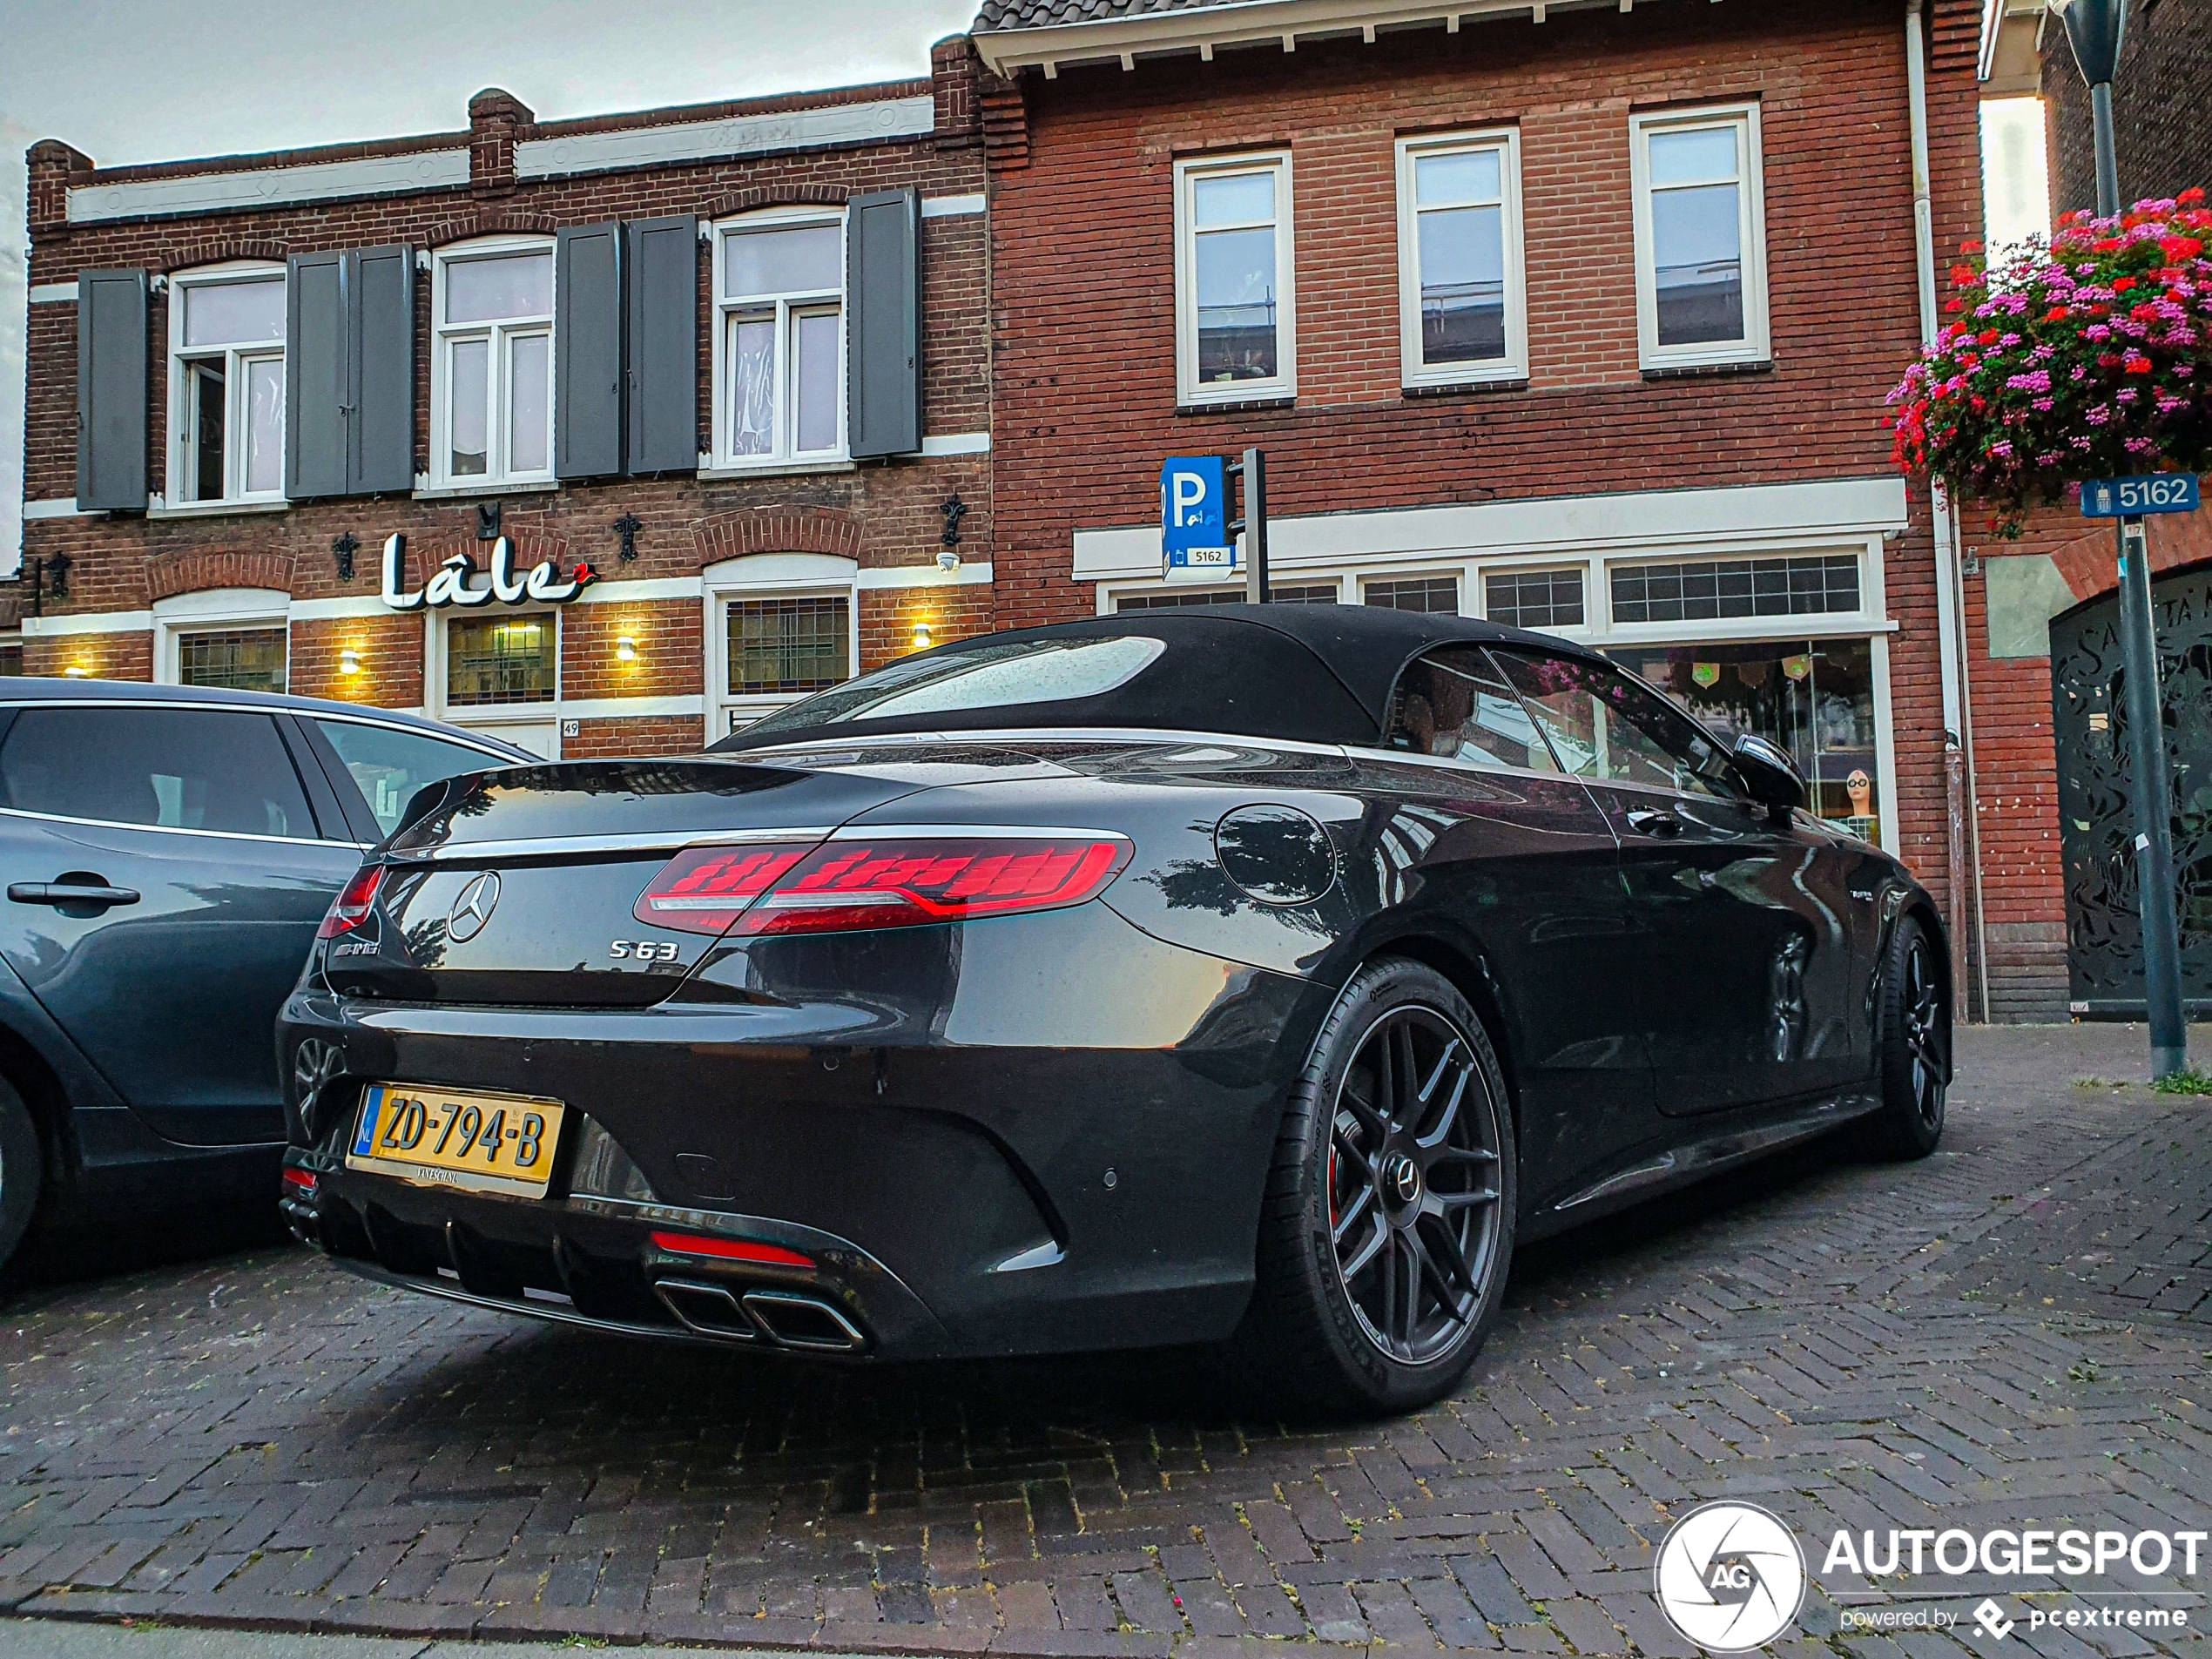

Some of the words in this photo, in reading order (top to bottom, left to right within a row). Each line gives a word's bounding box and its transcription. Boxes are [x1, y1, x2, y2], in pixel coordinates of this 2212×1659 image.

[1172, 472, 1206, 528] P
[2119, 478, 2189, 507] 5162
[1196, 550, 1222, 562] 5162
[381, 532, 581, 610] Lâle
[565, 723, 578, 734] 49
[610, 940, 630, 959] S
[636, 941, 678, 961] 63
[360, 1127, 371, 1143] NL
[381, 1098, 546, 1167] ZD-794-B
